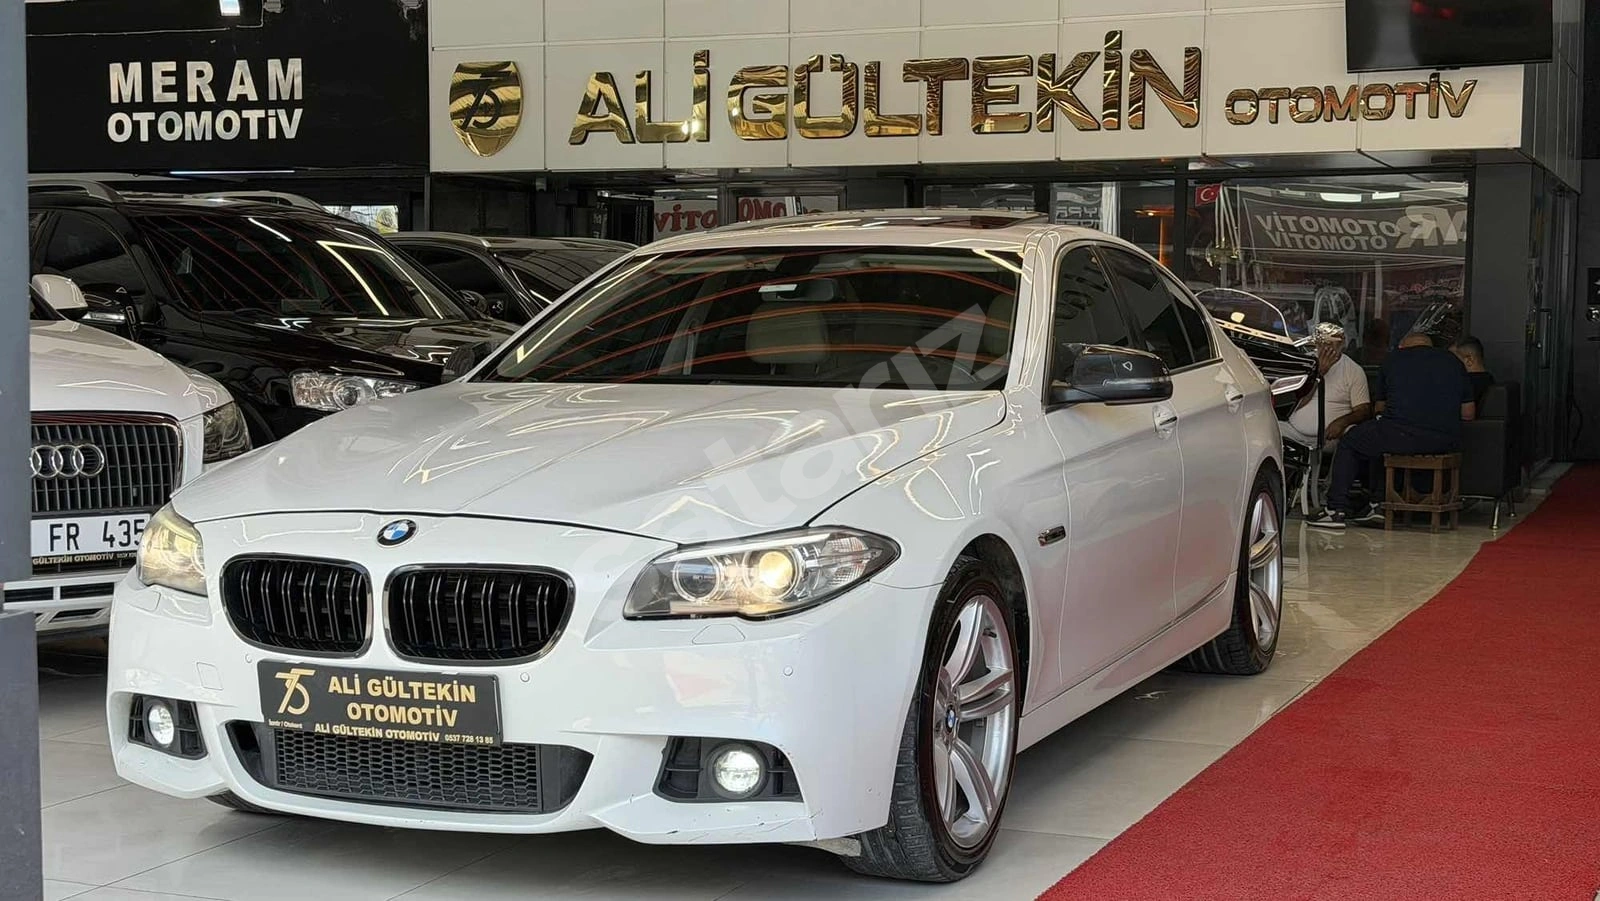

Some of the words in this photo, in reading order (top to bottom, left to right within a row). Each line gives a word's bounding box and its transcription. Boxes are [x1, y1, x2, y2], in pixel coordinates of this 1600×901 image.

[108, 58, 304, 104] MERAM
[568, 49, 710, 145] ALİ
[727, 30, 1202, 142] GÜLTEKİN
[1224, 72, 1478, 126] OTOMOTİV
[50, 523, 80, 552] FR
[74, 552, 115, 563] OTOMOTİV
[328, 673, 361, 695] ALİ
[367, 675, 476, 702] GÜLTEKİN
[346, 702, 458, 727] OTOMOTİV
[314, 722, 331, 733] ALİ
[332, 723, 383, 738] GÜLTEKİN
[385, 729, 441, 743] OTOMOTİV
